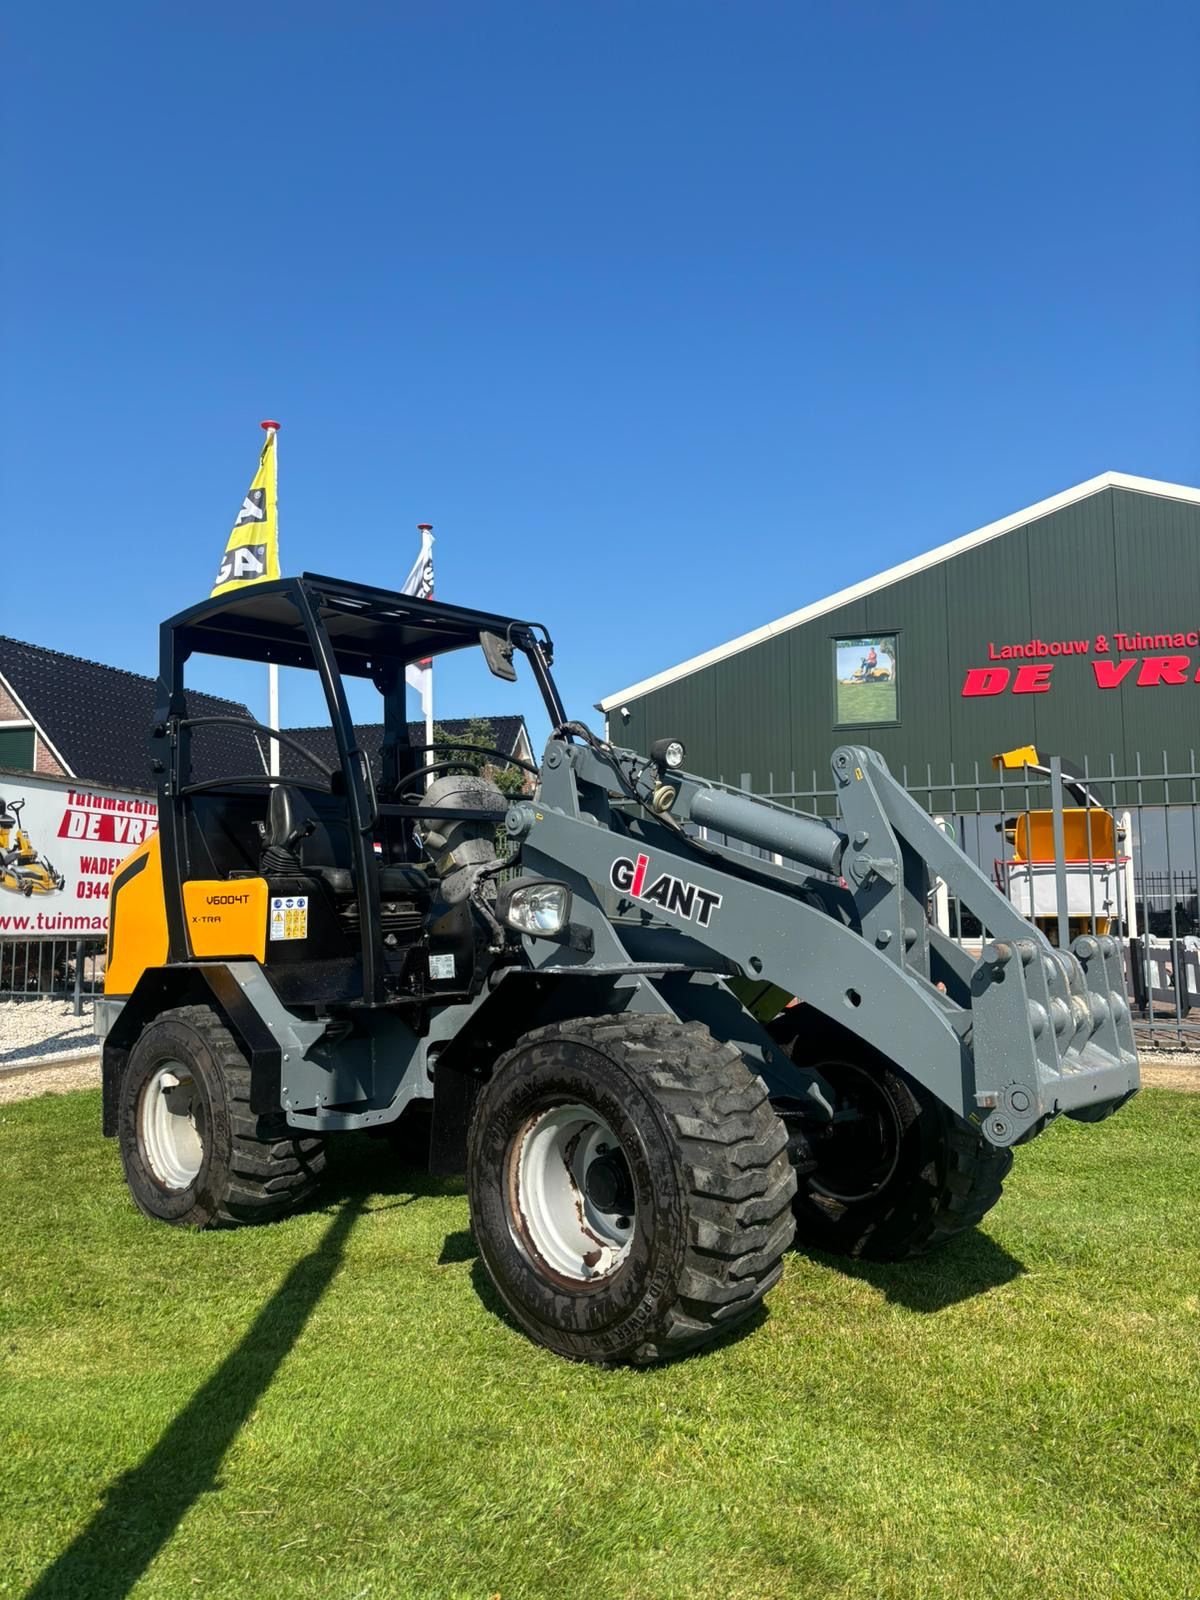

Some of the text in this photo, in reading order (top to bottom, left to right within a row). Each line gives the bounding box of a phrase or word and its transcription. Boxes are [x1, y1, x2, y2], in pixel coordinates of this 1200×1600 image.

[988, 629, 1200, 660] Landbouw & Tuinmac
[962, 655, 1200, 697] DE VR
[68, 812, 101, 839] DE
[77, 880, 109, 900] 0344
[206, 894, 250, 906] V6004T
[192, 915, 221, 923] X-TRA
